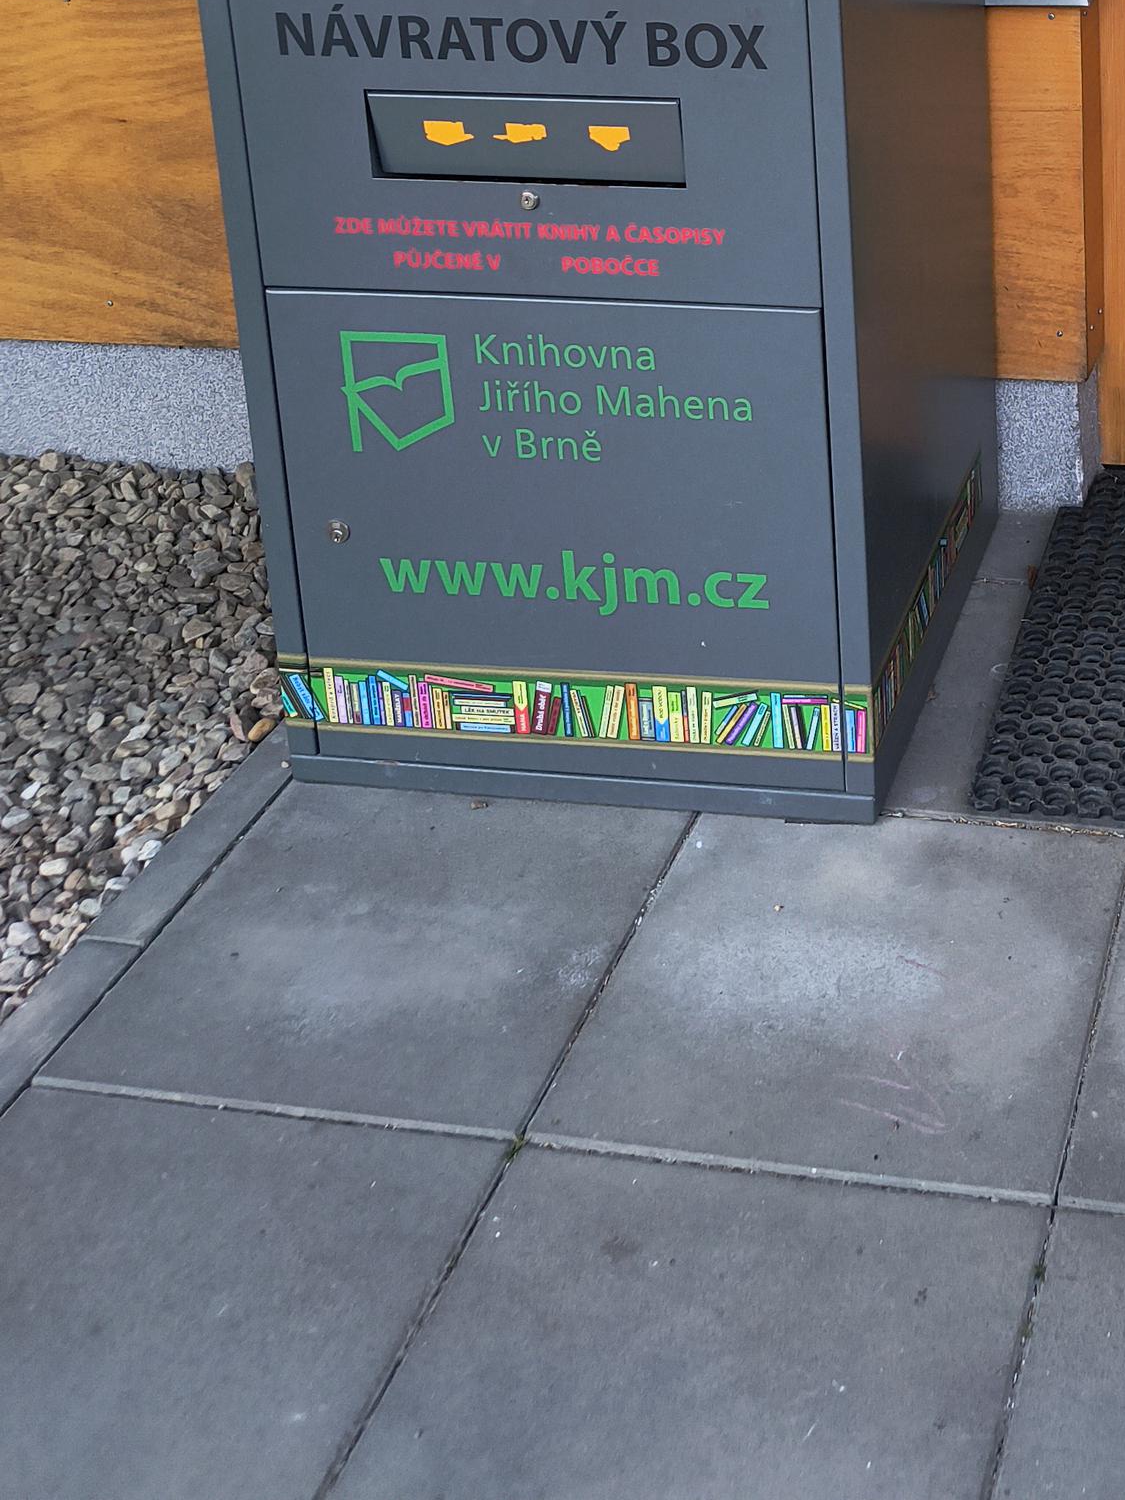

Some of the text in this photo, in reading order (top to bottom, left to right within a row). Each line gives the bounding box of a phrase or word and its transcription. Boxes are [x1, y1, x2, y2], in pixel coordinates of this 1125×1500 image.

[275, 3, 769, 71] NÁVRATOVÝ BOX
[335, 214, 727, 246] ZDE MŮŽETE VRÁTIT KNIHY A ČASOPISY
[393, 247, 661, 277] PŮJČENÉ V POBOČCE
[473, 332, 656, 372] Knihovna
[478, 380, 753, 422] Jiřího Mahena
[482, 427, 603, 462] v Brně
[379, 549, 771, 617] www.kjm.cz
